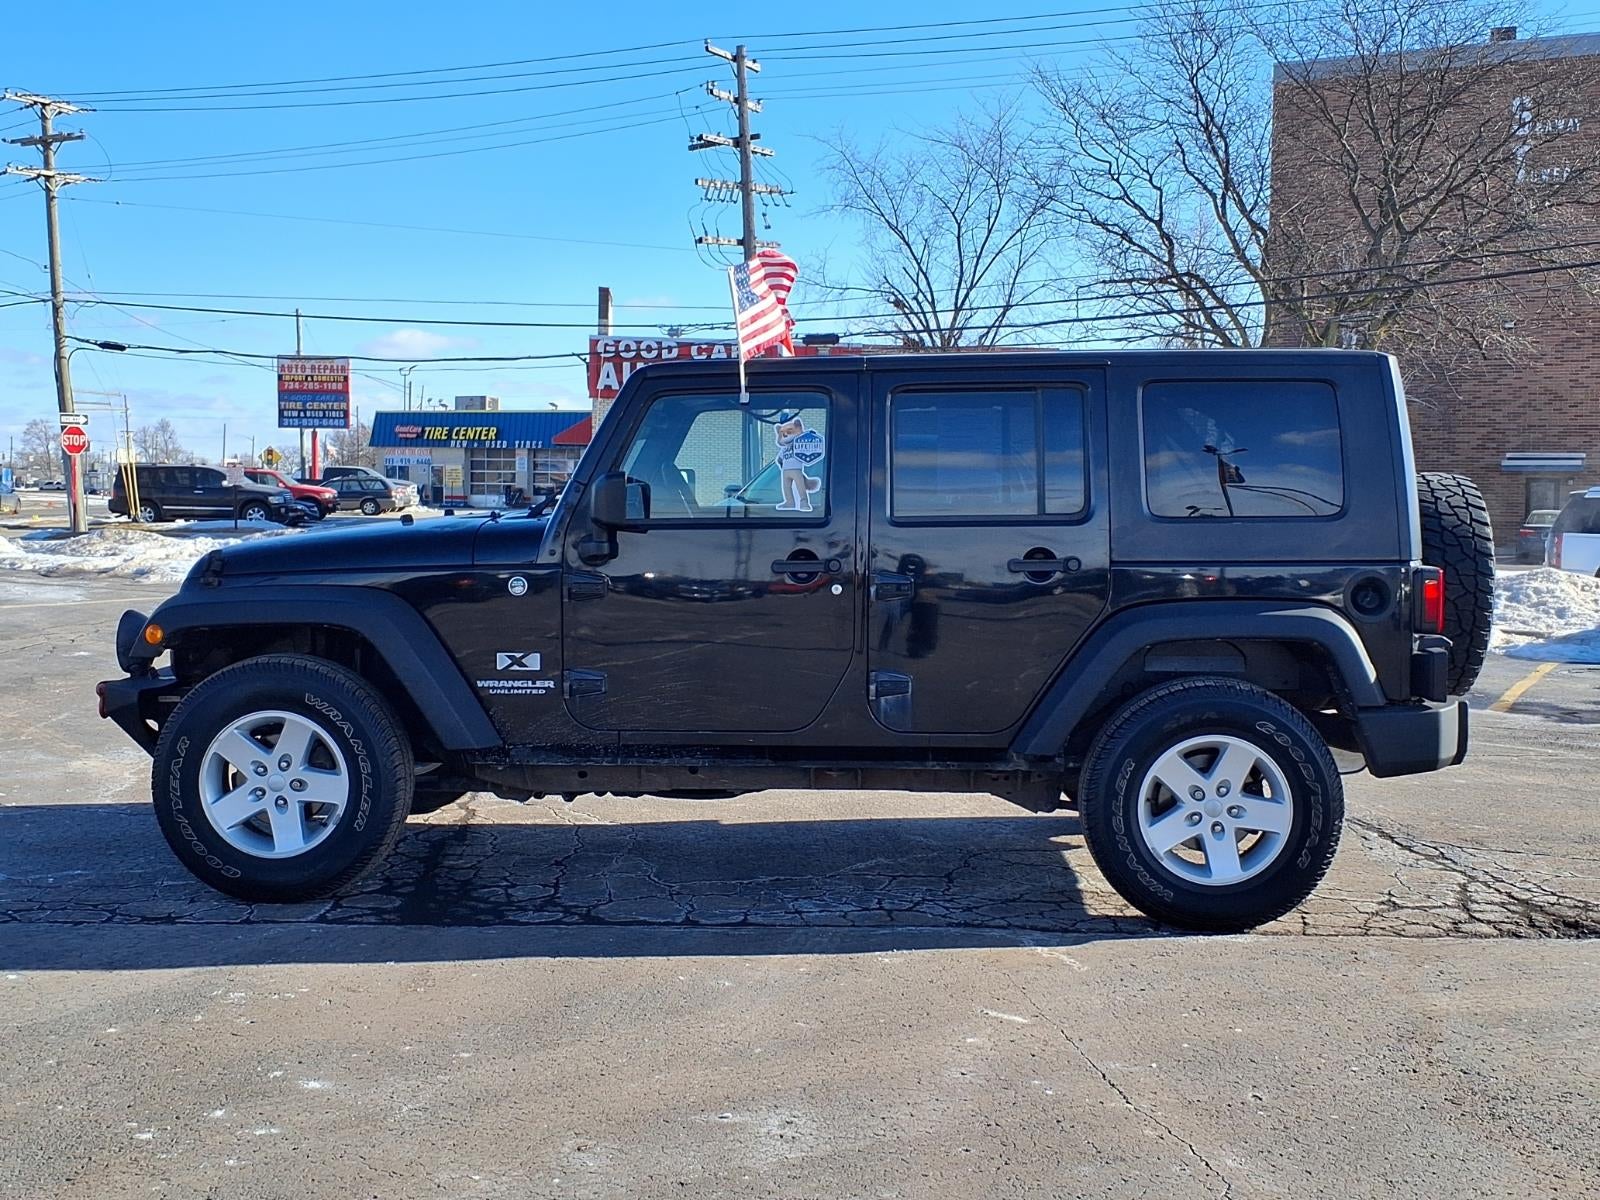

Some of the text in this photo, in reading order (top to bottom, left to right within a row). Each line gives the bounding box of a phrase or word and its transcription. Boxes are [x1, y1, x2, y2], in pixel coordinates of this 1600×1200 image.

[597, 340, 678, 360] GOOD
[280, 364, 346, 375] AUTO REPAIR
[306, 402, 347, 410] CENTER
[423, 426, 448, 440] TIRE
[452, 426, 497, 440] CENTER
[63, 434, 86, 447] STOP
[450, 440, 468, 448] NEW
[485, 440, 508, 448] USED
[514, 440, 543, 448] TIRES
[476, 680, 555, 688] WRANGLER
[304, 692, 372, 832] WRANGLER
[1255, 720, 1324, 870] GOODYEAR
[167, 735, 242, 879] GOODYEAR
[1111, 758, 1174, 903] WRANGLER
